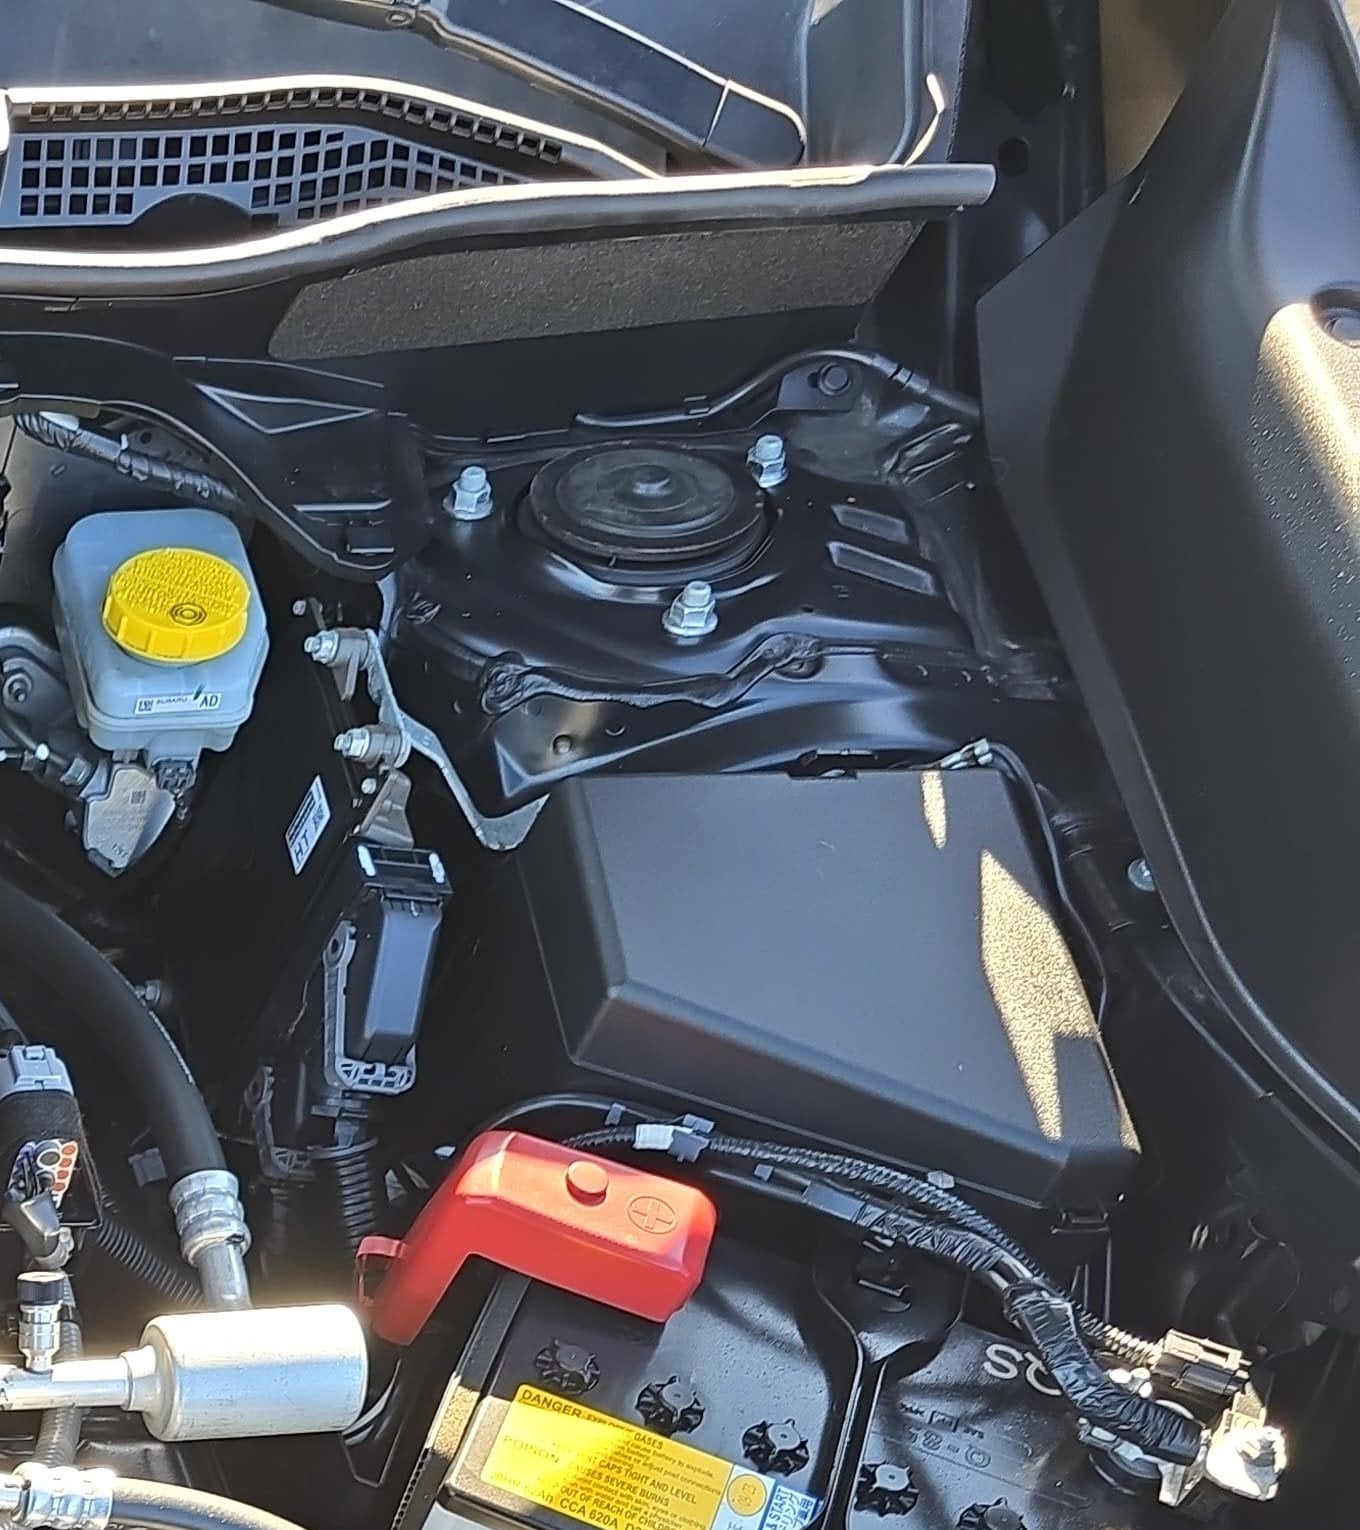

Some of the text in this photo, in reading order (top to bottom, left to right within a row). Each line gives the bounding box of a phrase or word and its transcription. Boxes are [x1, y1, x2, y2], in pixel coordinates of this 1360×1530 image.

[200, 695, 219, 708] AD
[521, 1388, 582, 1420] DANGER
[598, 1458, 623, 1475] CAPS
[622, 1468, 649, 1485] TIGHT
[648, 1478, 670, 1493] AND
[668, 1486, 698, 1504] LEVEL
[602, 1474, 639, 1495] SEVERE
[638, 1488, 670, 1507] BURNS
[557, 1496, 588, 1517] CCA
[588, 1508, 620, 1529] 620A
[559, 1484, 578, 1498] OUT
[578, 1492, 592, 1503] OF
[592, 1497, 624, 1516] REACH
[623, 1509, 637, 1521] OF
[767, 1487, 790, 1521] START
